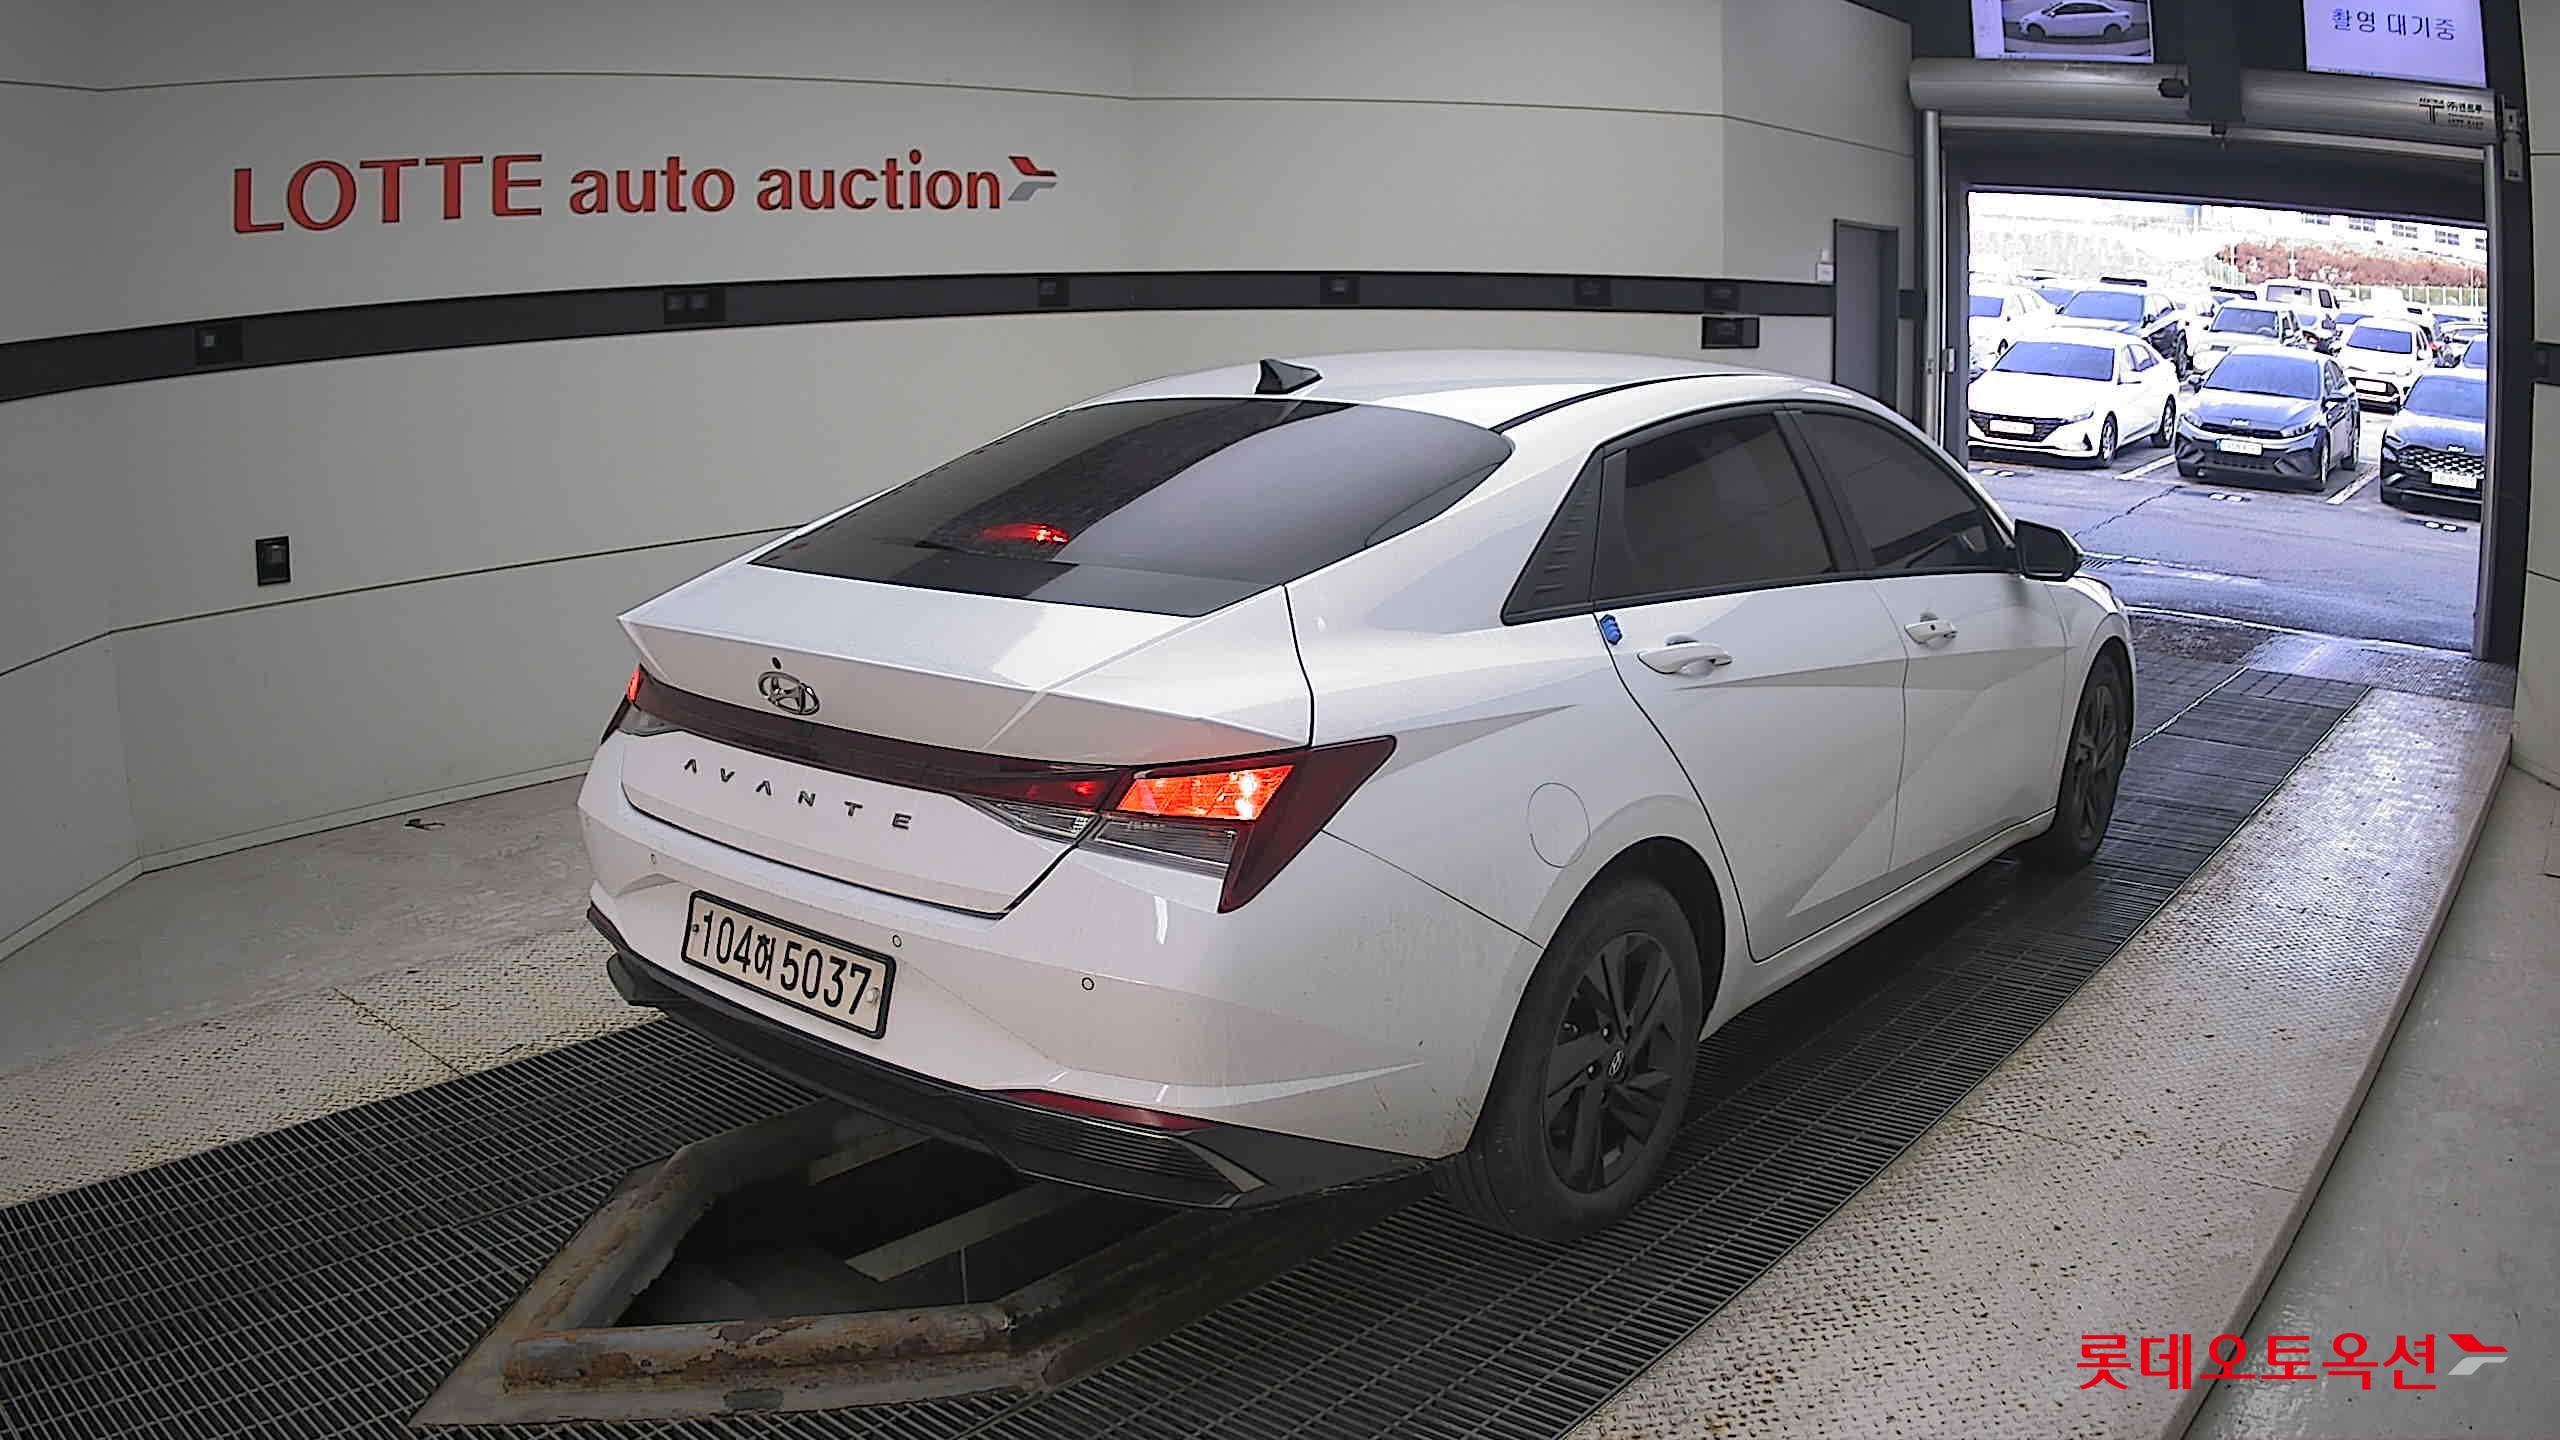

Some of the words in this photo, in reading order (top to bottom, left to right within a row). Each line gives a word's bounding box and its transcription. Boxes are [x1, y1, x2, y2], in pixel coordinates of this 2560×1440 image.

[2332, 8, 2376, 33] 촬영
[2387, 13, 2456, 41] 대기중
[233, 154, 543, 233] LOTTE
[569, 155, 736, 215] auto
[757, 149, 1002, 210] auction
[684, 758, 913, 831] AVANTE
